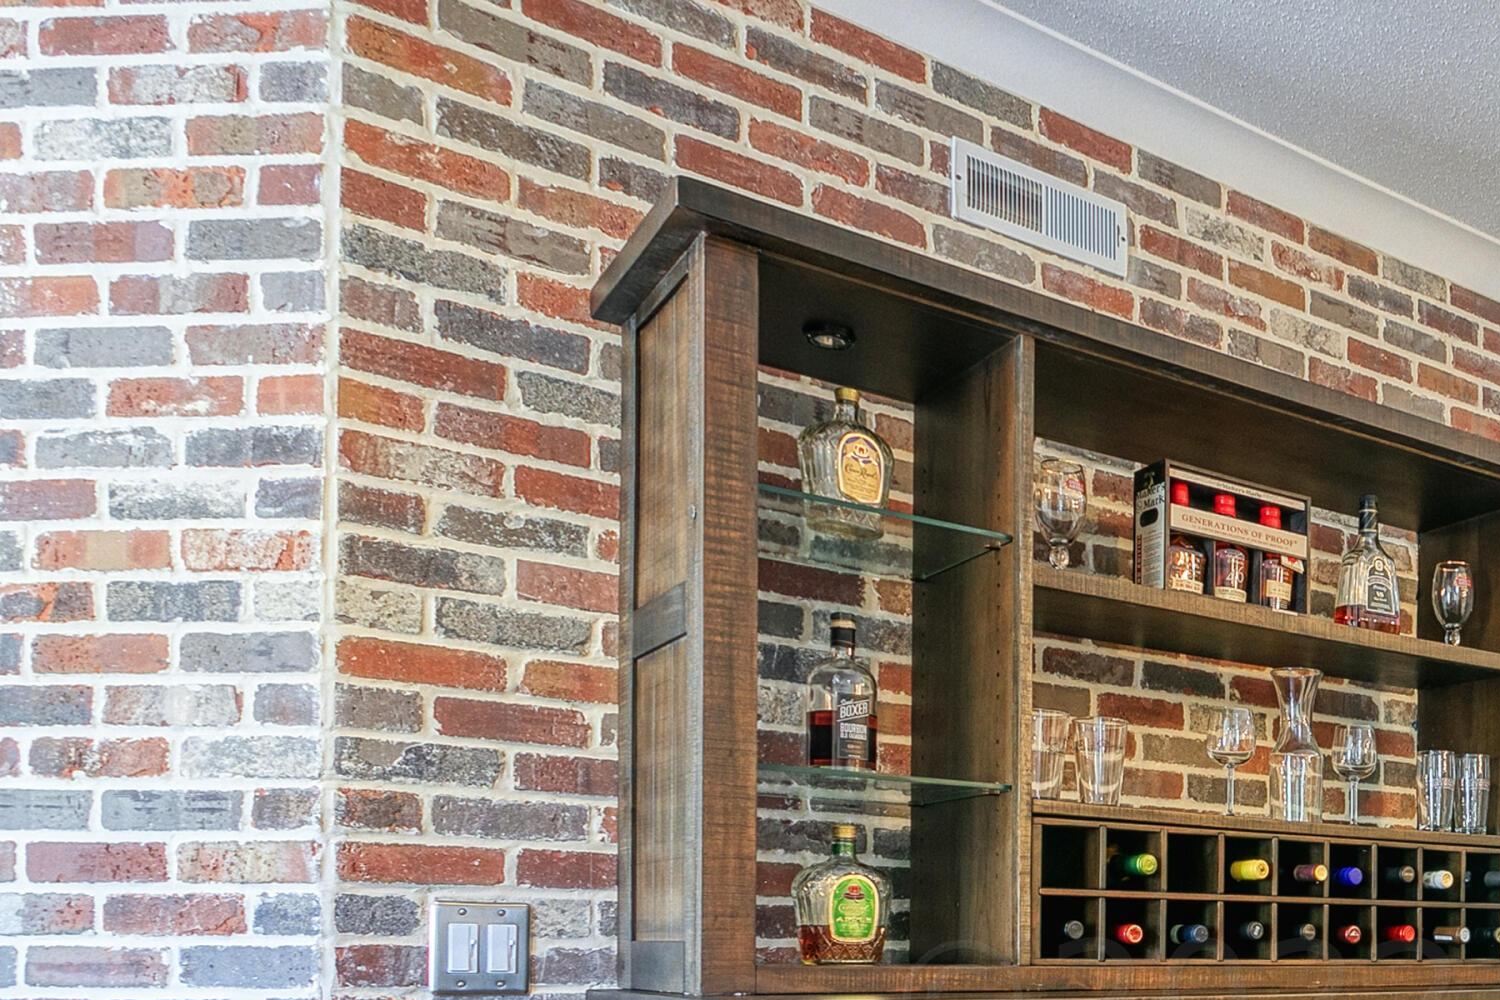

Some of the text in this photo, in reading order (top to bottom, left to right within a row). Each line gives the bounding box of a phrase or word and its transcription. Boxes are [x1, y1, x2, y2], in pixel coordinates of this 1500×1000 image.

[1181, 513, 1249, 537] GENERATIONS
[1251, 530, 1262, 539] OF
[840, 702, 868, 718] BOXER
